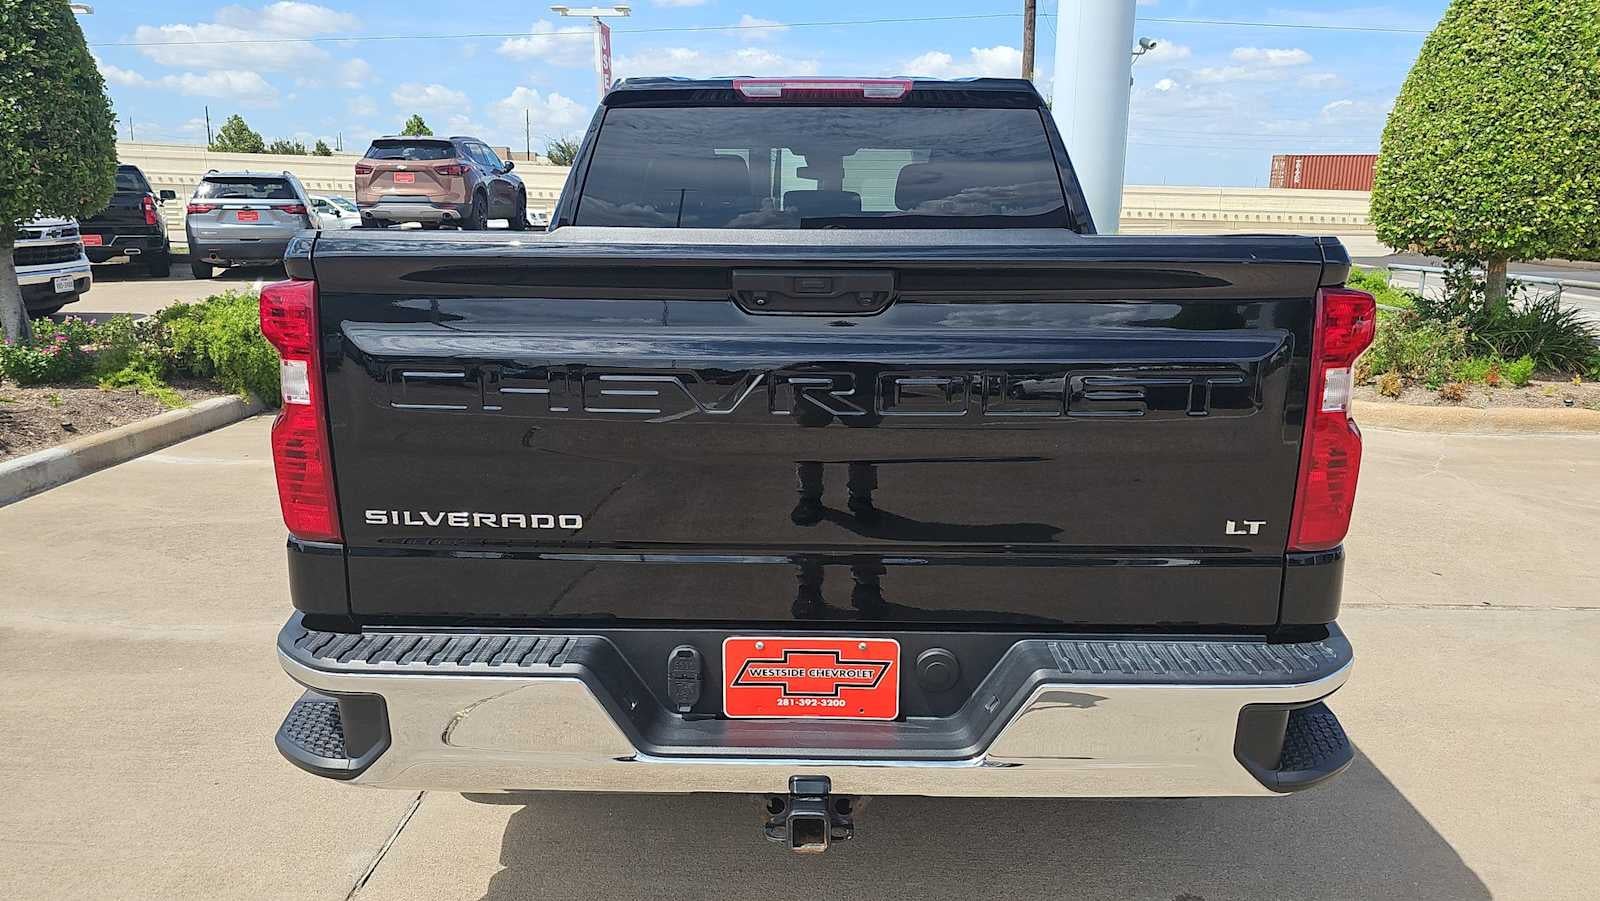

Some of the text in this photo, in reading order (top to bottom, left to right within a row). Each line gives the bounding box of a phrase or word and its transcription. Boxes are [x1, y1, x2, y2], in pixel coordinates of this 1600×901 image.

[389, 366, 1260, 417] CHEVROLET
[365, 509, 584, 530] SILVERADO
[1225, 520, 1267, 535] LT
[749, 668, 875, 679] WESTSIDE CHEVROLET
[776, 698, 847, 707] 281-392-3200
